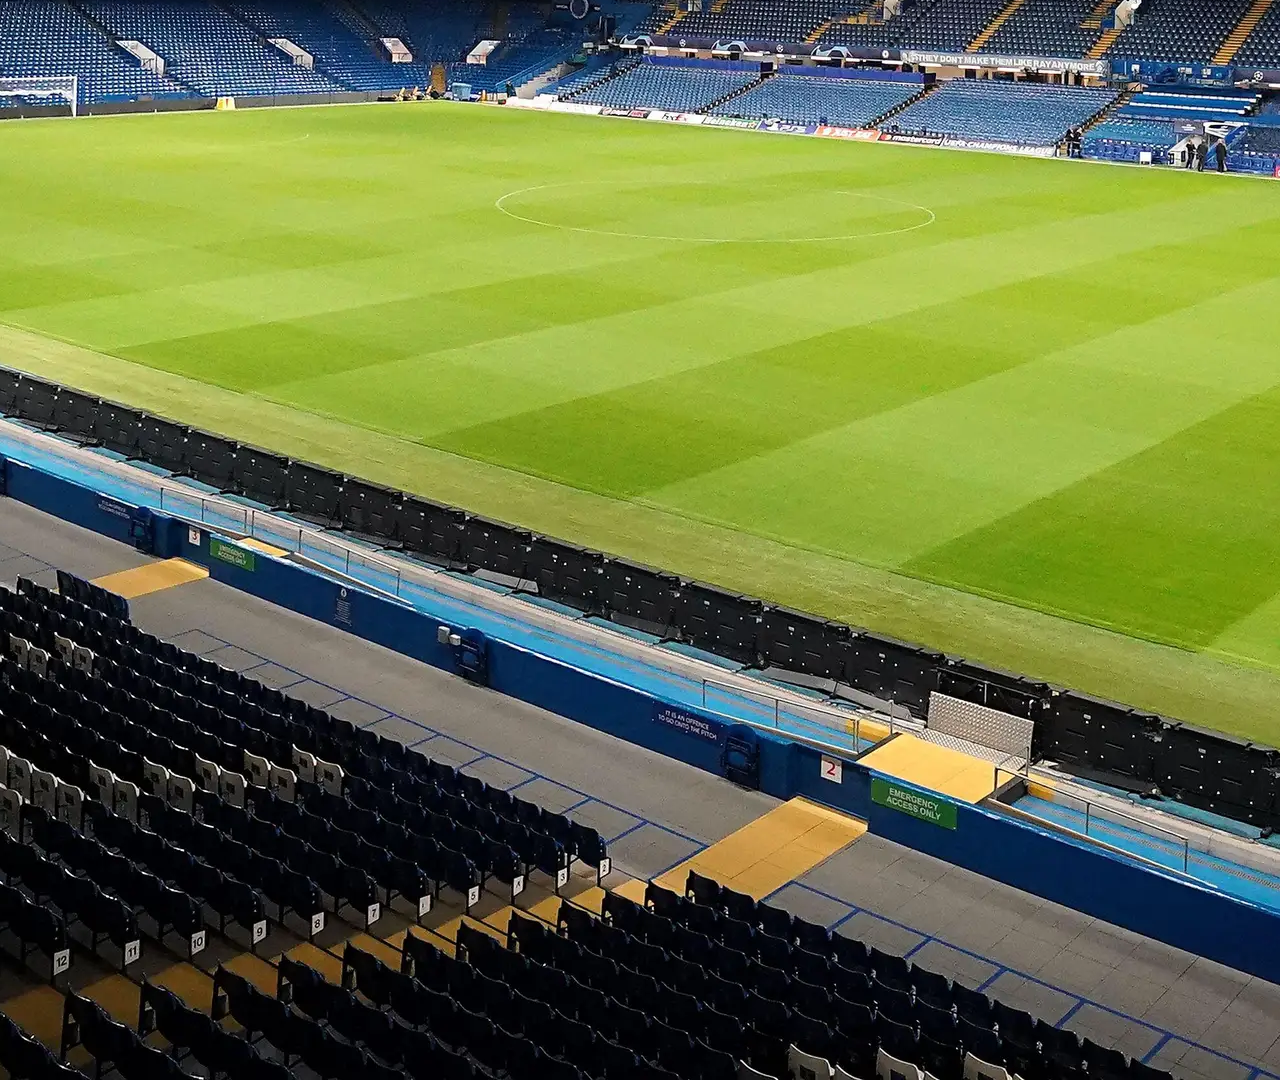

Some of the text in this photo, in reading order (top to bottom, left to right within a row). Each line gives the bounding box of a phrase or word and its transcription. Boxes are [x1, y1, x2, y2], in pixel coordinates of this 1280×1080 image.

[917, 53, 939, 63] THEY
[940, 55, 963, 65] DONT
[964, 56, 989, 66] MAKE
[989, 57, 1012, 67] THEM
[1033, 61, 1052, 69] RAY
[1051, 61, 1096, 71] ANYMORE
[704, 116, 750, 128] Heineken
[843, 129, 884, 139] JUST EAT
[892, 135, 942, 145] mastercard
[967, 141, 1018, 152] CHAMPIONS
[1019, 146, 1053, 156] LEAGUE
[677, 713, 685, 721] AN
[685, 717, 710, 730] OFFENCE
[666, 716, 674, 724] GO
[674, 719, 690, 730] ONTO
[690, 725, 701, 735] THE
[701, 728, 718, 741] PITCH
[826, 761, 836, 776] 2
[889, 787, 939, 812] EMERGENCY
[886, 796, 942, 821] ACCESS ONLY
[560, 873, 566, 882] 3
[471, 891, 476, 900] 5
[371, 908, 377, 918] 7
[314, 919, 321, 929] 8
[256, 927, 263, 937] 9
[193, 936, 203, 948] 10
[128, 946, 137, 957] 11
[56, 955, 67, 967] 12
